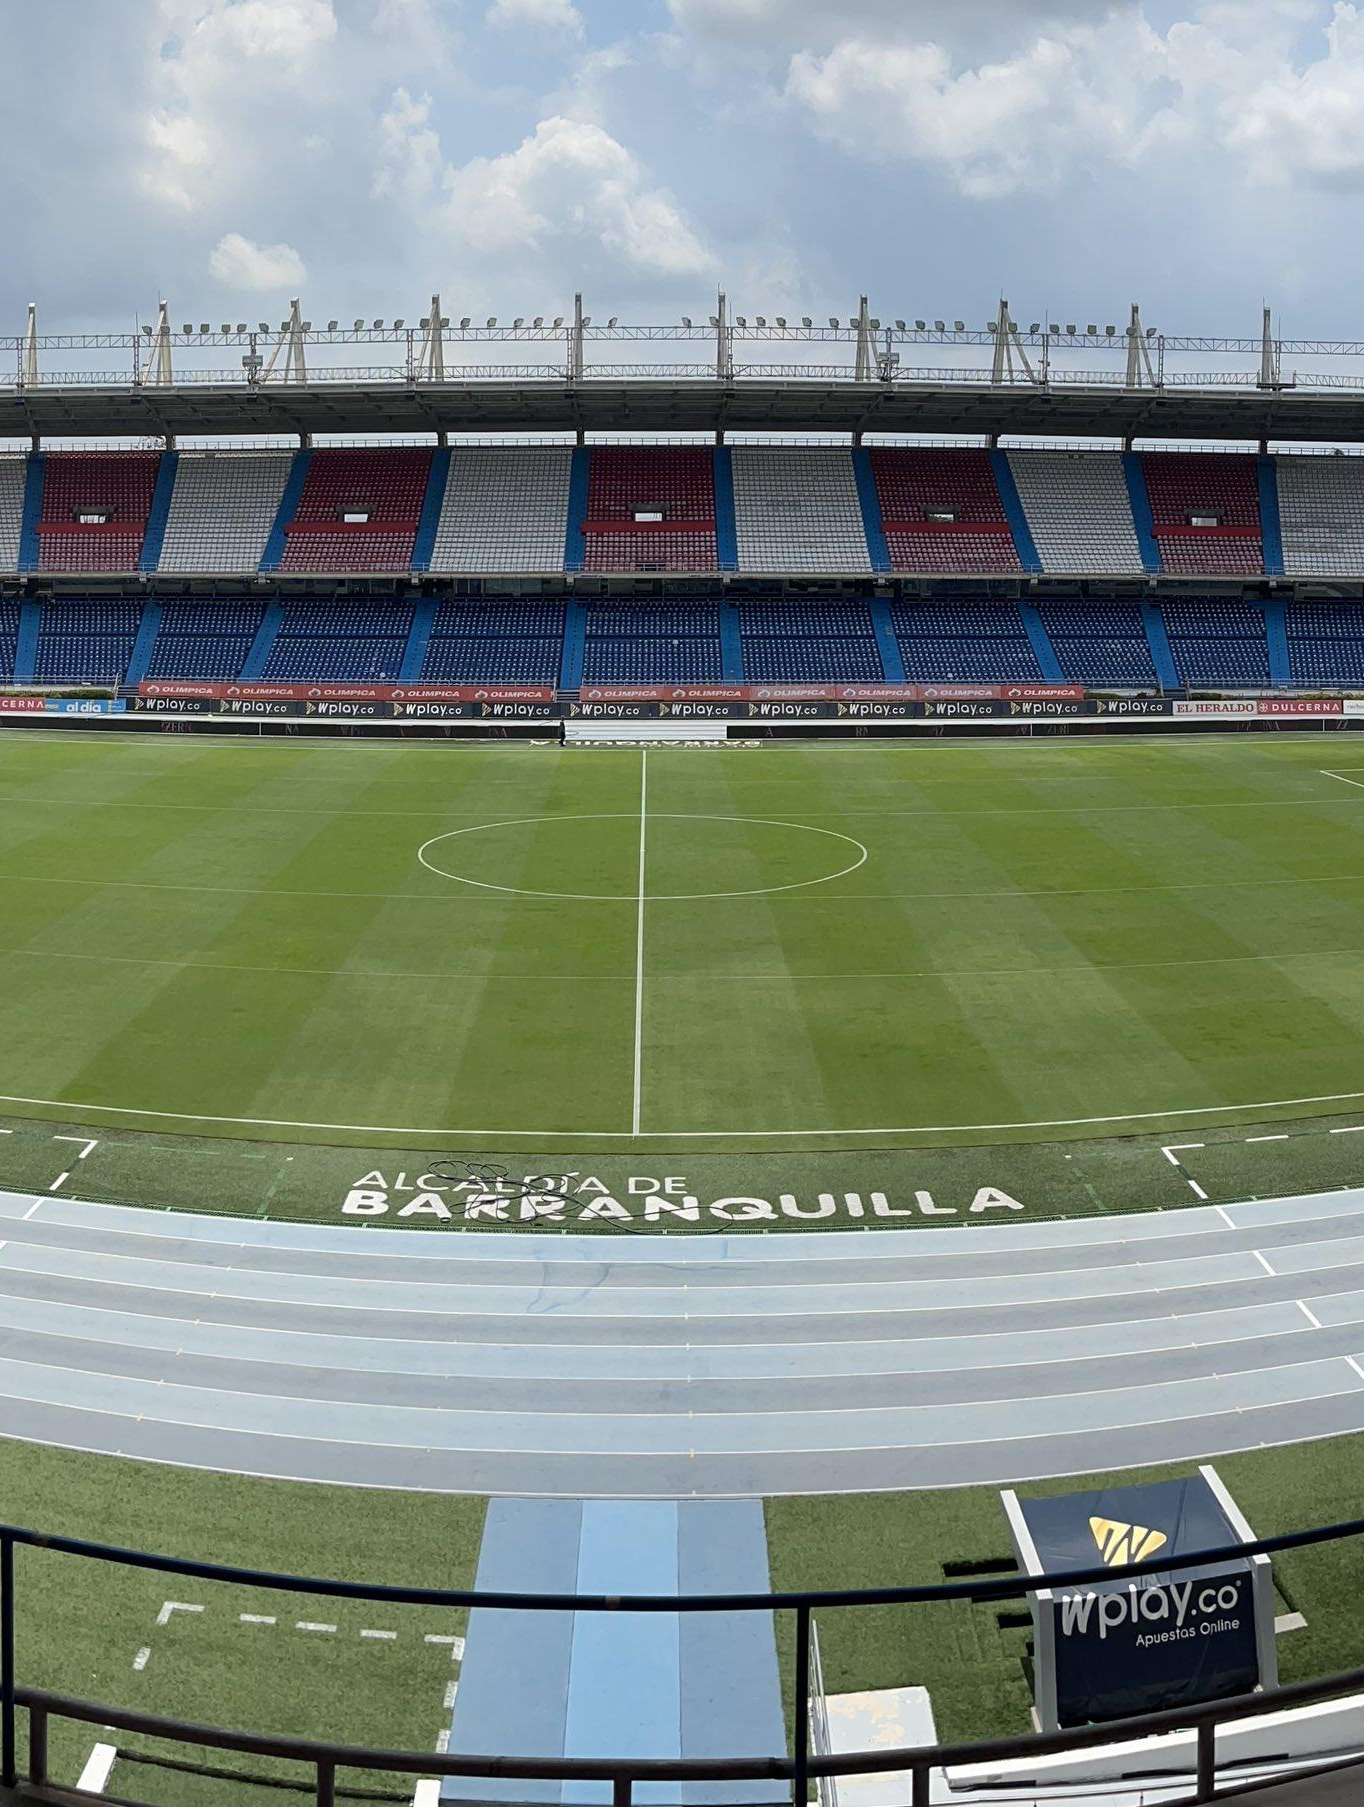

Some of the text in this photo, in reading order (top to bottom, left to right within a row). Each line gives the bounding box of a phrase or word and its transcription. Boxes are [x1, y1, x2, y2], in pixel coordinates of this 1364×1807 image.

[1177, 703, 1254, 713] EL HERALDO
[1272, 703, 1340, 711] DULCERNA
[628, 1176, 688, 1194] DE
[341, 1187, 1025, 1221] BARRANQUILLA
[1135, 1619, 1240, 1648] Apuestas Online
